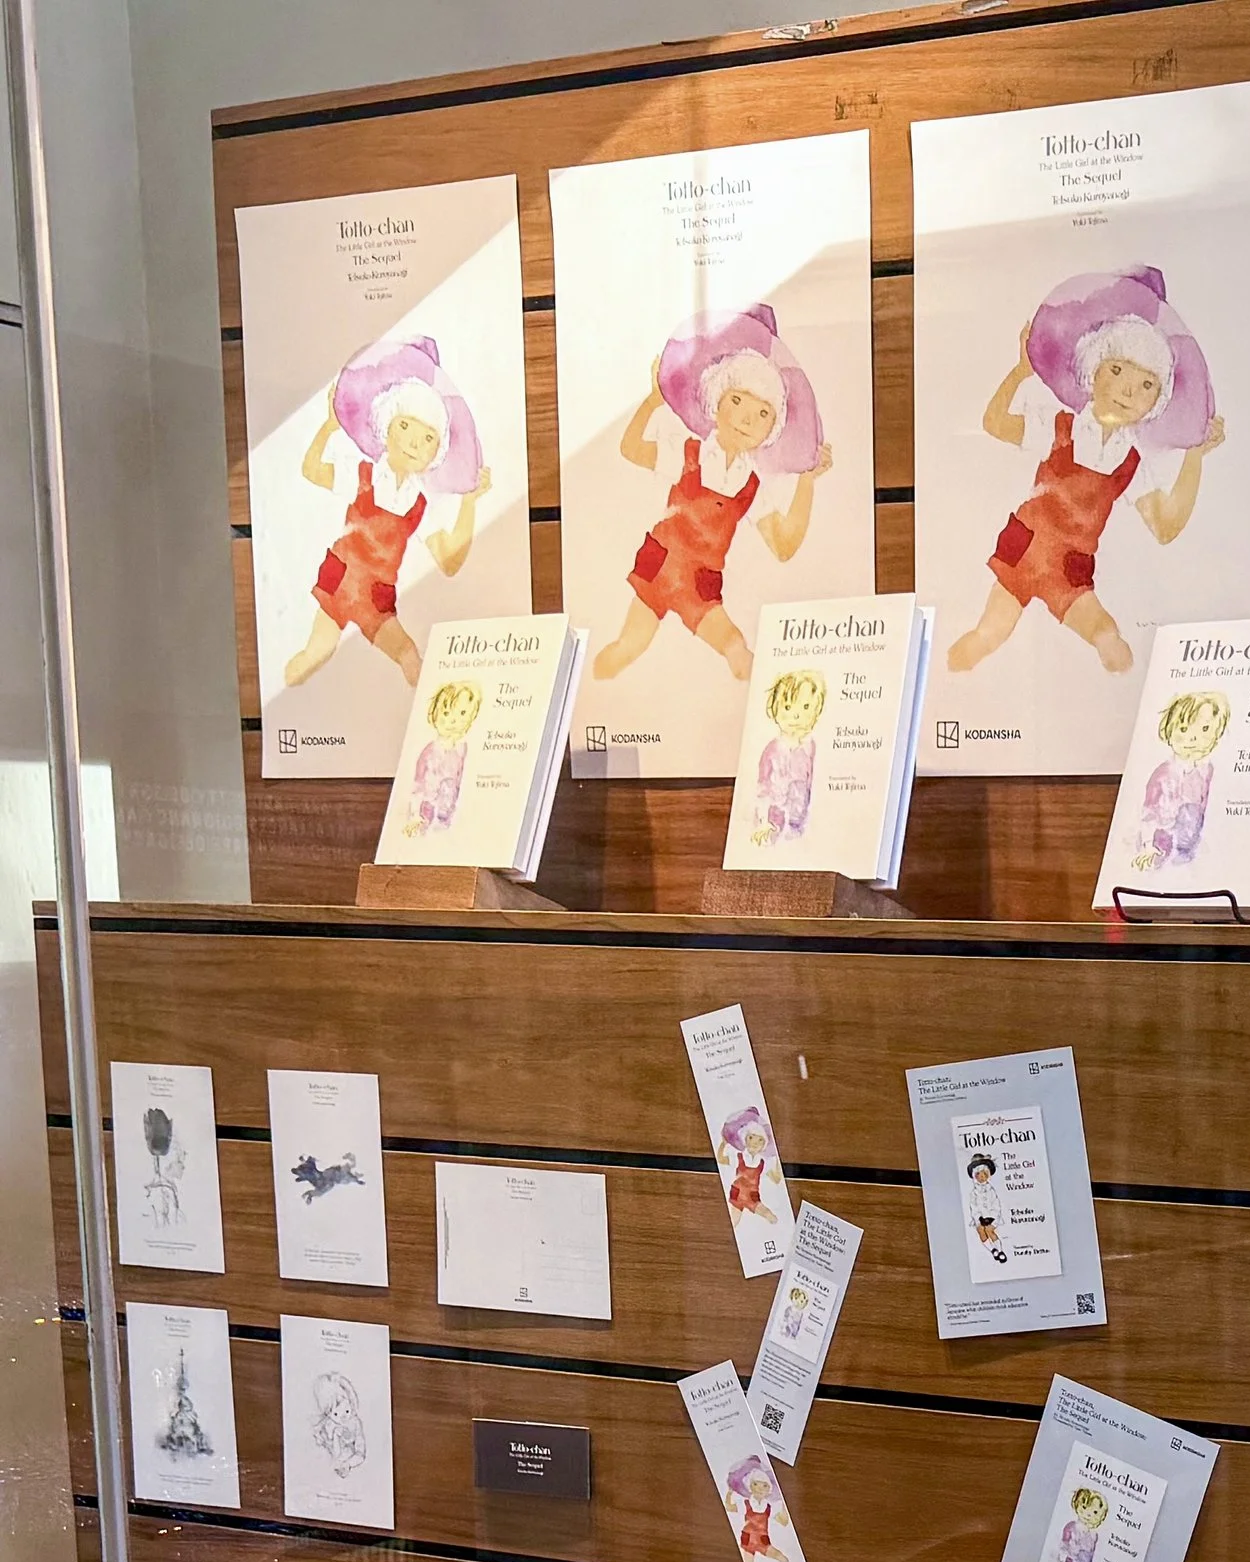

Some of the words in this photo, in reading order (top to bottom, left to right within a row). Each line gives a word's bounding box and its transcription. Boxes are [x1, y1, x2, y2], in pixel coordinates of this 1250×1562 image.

[1040, 130, 1141, 156] Totto-chan
[779, 615, 885, 641] Totto-chan
[843, 672, 867, 685] The
[840, 687, 883, 702] Sequel
[611, 734, 661, 744] KODANSHA
[965, 729, 1021, 740] KODANSHA
